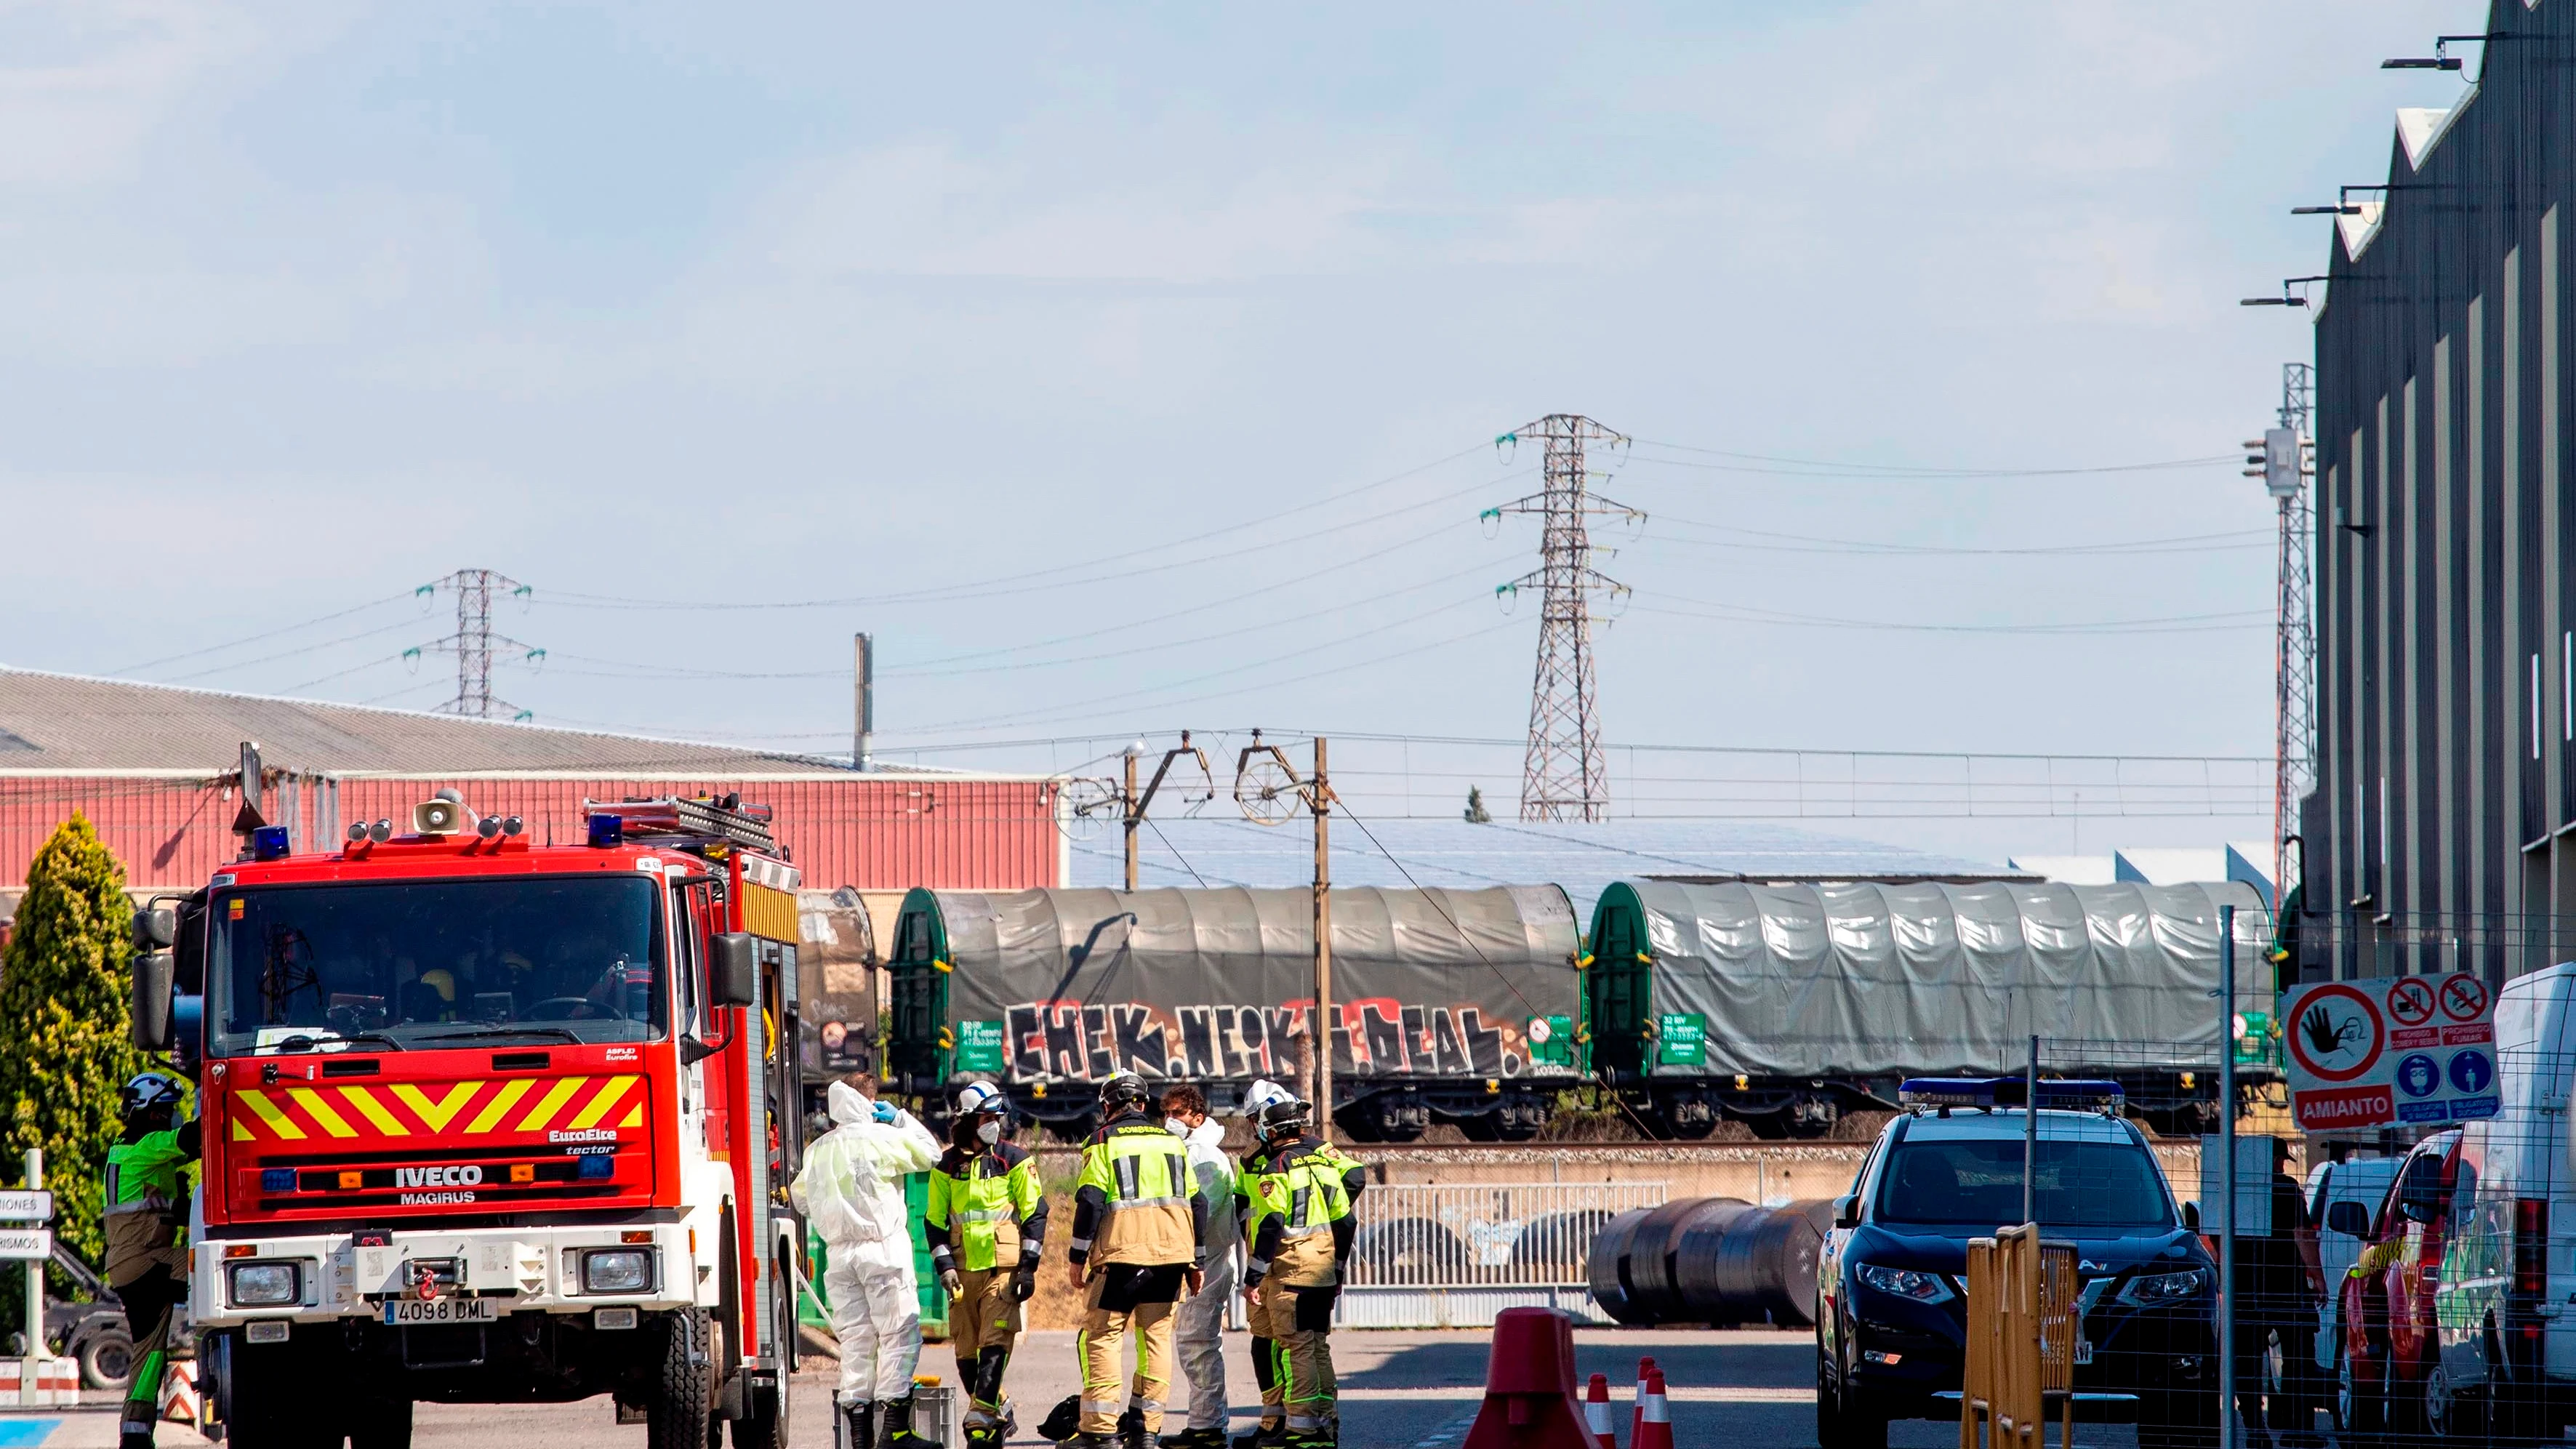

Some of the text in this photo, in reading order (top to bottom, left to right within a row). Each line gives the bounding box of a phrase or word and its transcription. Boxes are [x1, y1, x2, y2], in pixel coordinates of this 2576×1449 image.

[2398, 1029, 2431, 1039] PROHIBIDO
[2442, 1024, 2489, 1036] PROHIBIDO
[2452, 1034, 2483, 1043] FUMAR
[2303, 1096, 2388, 1119] AMIANTO
[1117, 1125, 1168, 1134] BOMBEROS
[566, 1145, 615, 1155] tector
[396, 1165, 483, 1189] IVECO
[401, 1191, 476, 1205] MAGIRUS
[399, 1301, 449, 1320] 4098
[455, 1300, 492, 1320] DML
